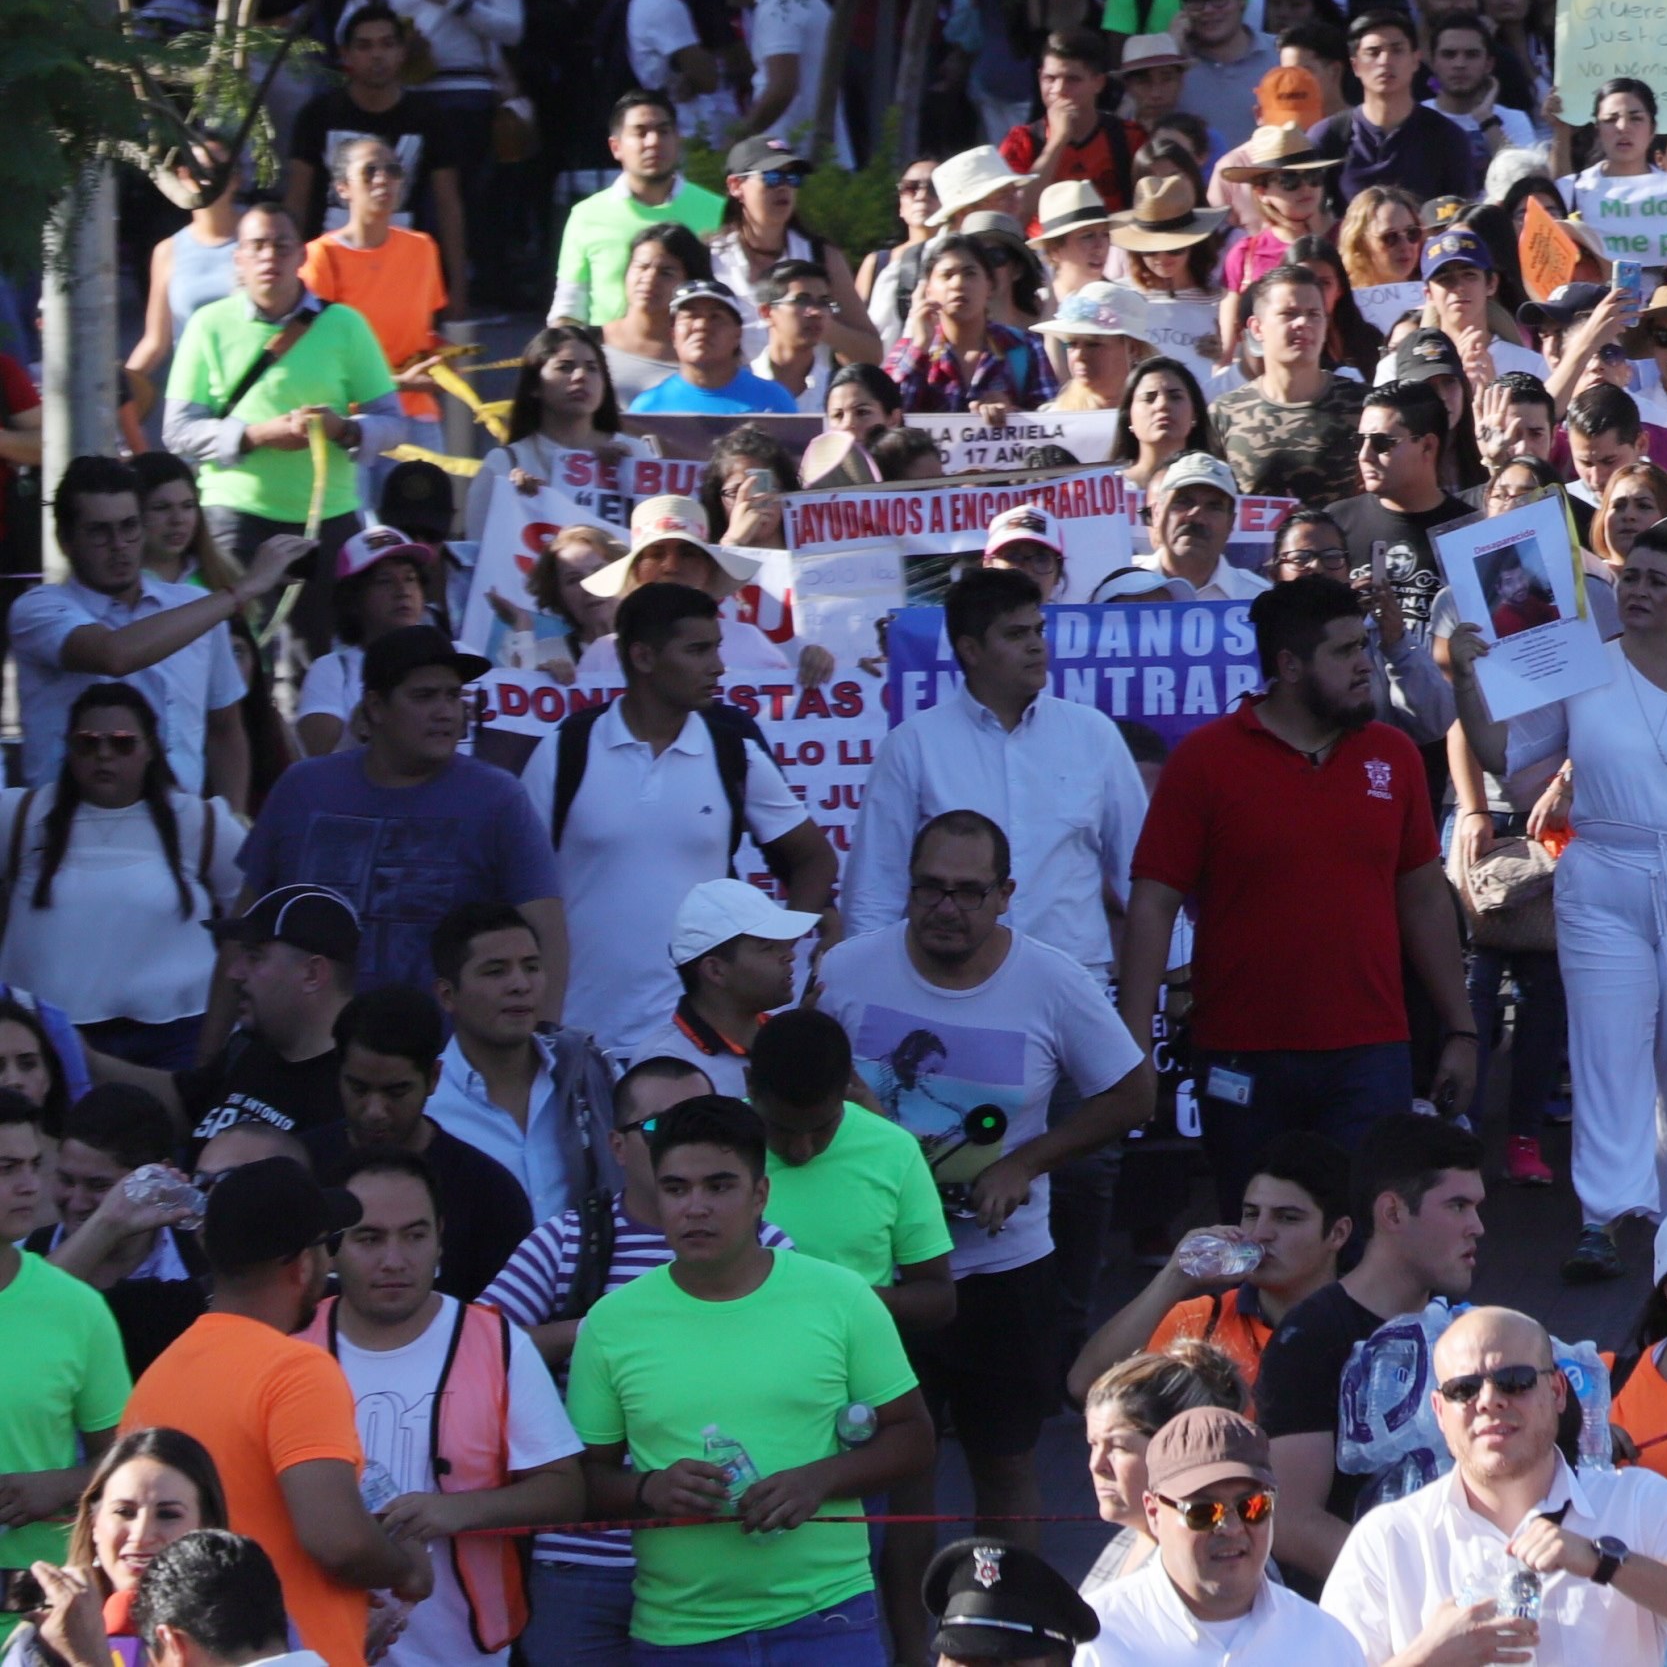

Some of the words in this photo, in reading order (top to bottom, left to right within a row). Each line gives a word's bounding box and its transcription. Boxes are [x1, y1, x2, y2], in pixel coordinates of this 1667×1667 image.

[1600, 198, 1632, 219] Mi
[1603, 231, 1658, 254] me
[961, 423, 1065, 444] GABRIELA
[964, 446, 987, 465] 17
[788, 494, 923, 550] ¡AYÚDANOS
[929, 501, 945, 535] A
[1474, 529, 1537, 555] Desaparecido
